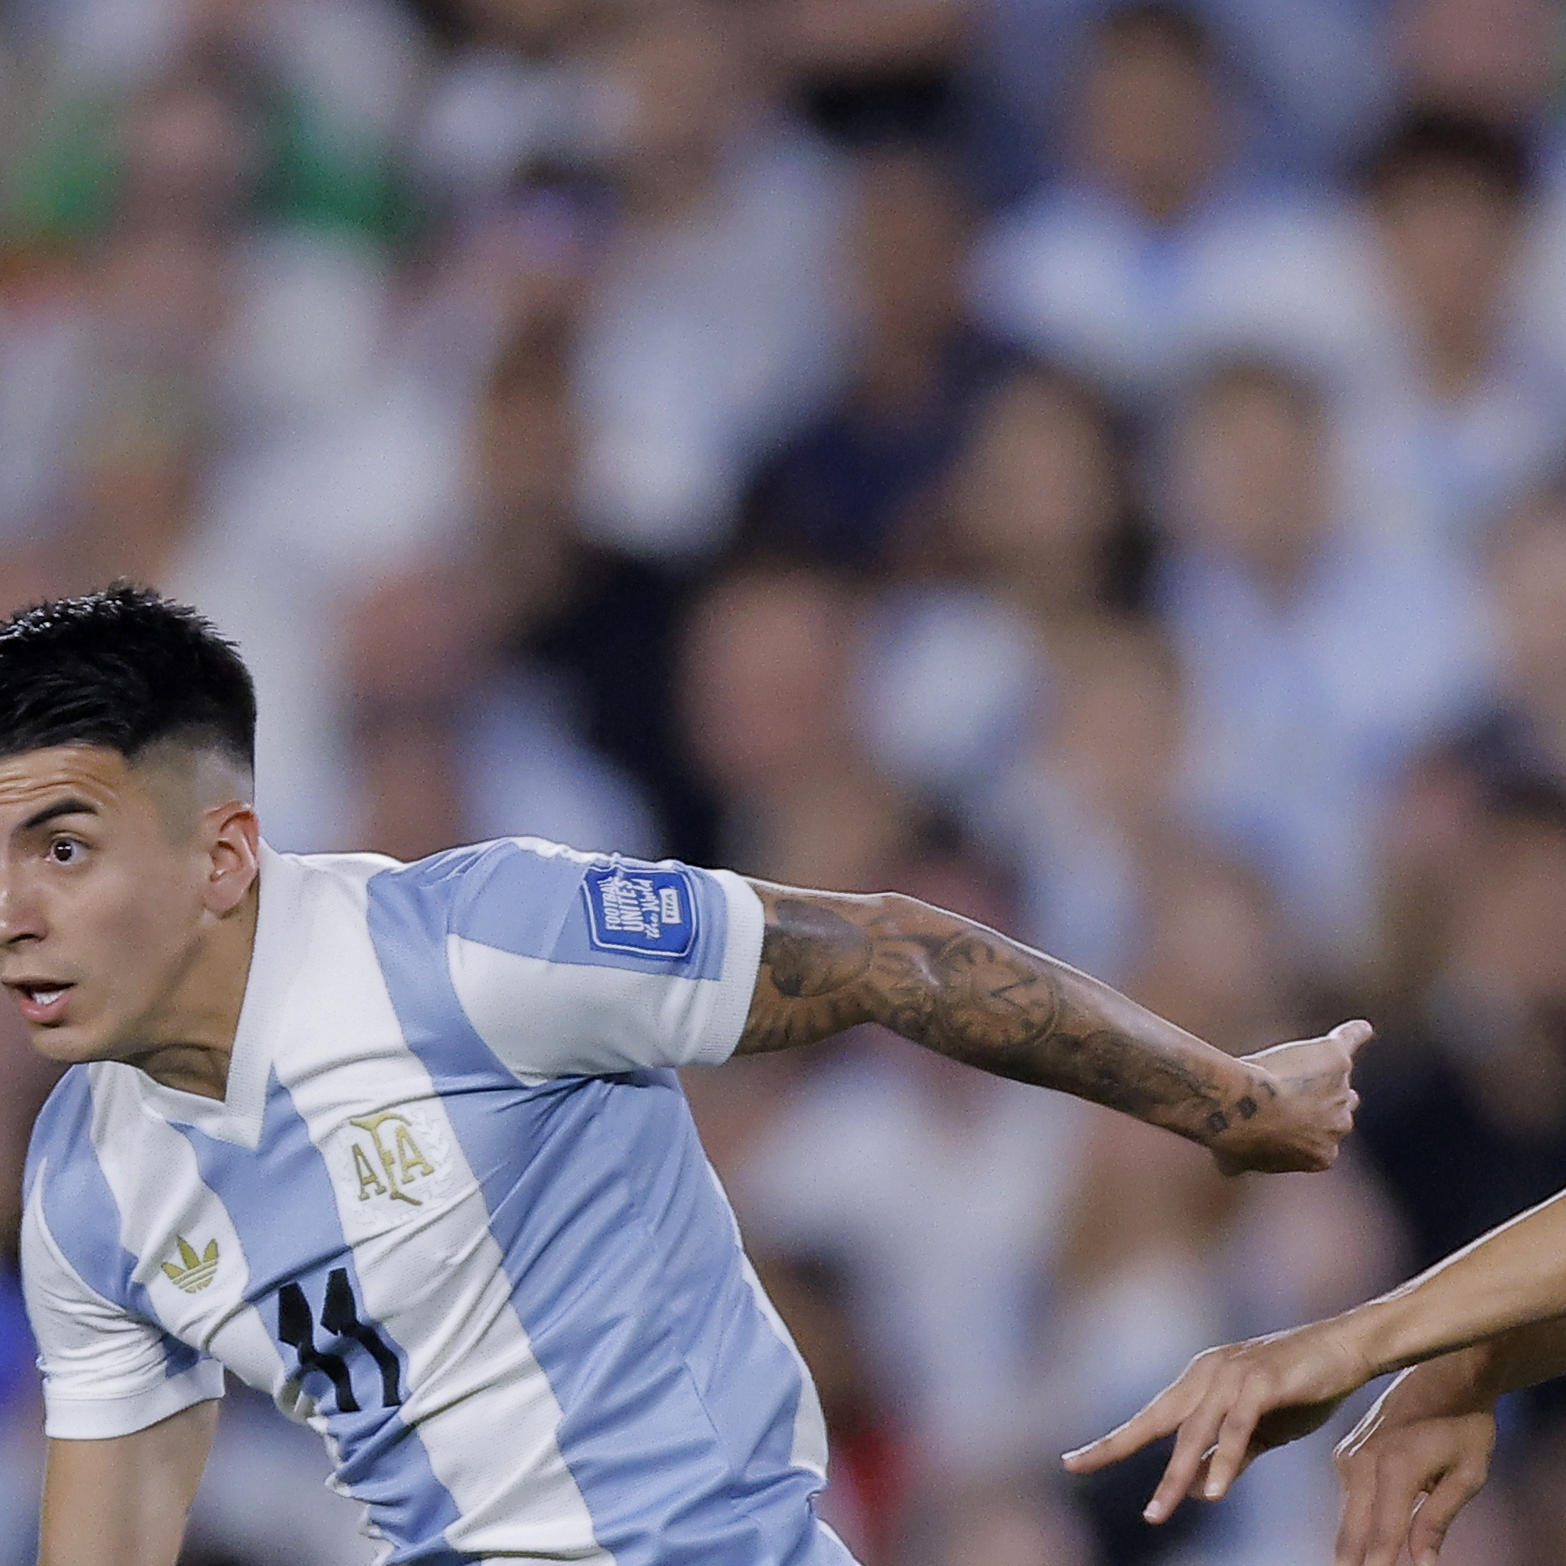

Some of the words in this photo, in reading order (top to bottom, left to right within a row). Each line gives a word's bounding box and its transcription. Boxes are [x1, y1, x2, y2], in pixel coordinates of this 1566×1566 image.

[596, 876, 622, 931] FOOTBALL
[614, 876, 645, 932] UNITES
[665, 893, 675, 919] FIFA
[277, 1267, 404, 1412] 11
